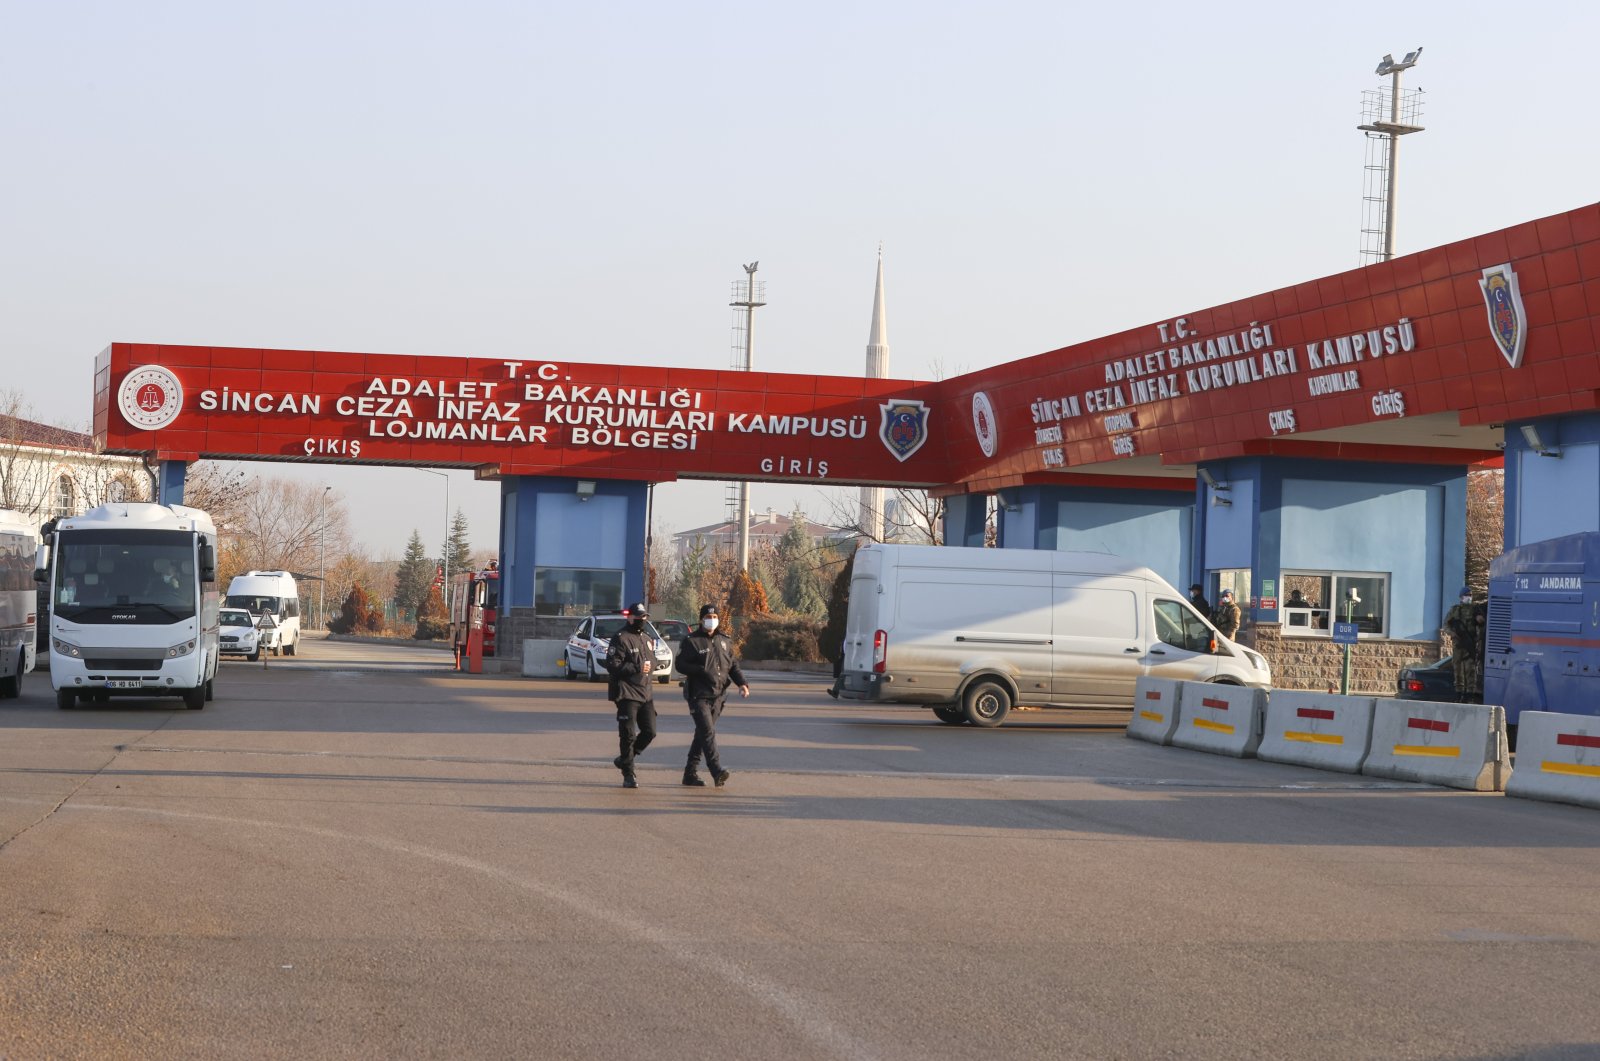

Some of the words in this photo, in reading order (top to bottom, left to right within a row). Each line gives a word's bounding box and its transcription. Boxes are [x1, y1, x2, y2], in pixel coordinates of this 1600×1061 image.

[1156, 317, 1197, 343] T.C.
[1104, 350, 1166, 383] ADALET
[1169, 321, 1274, 366] BAKANLIĞI
[504, 362, 571, 381] T.C.
[1031, 393, 1081, 424] SİNCAN
[1085, 384, 1124, 413] CEZA
[1131, 371, 1180, 405] İNFAZ
[1187, 348, 1297, 394] KURUMLARI
[1306, 318, 1415, 369] KAMPUSÜ
[1308, 370, 1360, 397] KURUMLAR
[366, 377, 497, 399] ADALET
[525, 384, 701, 409] BAKANLIĞI
[1371, 389, 1405, 418] GİRİŞ
[199, 386, 320, 415] SİNCAN
[336, 396, 413, 418] CEZA
[438, 395, 520, 423] İNFAZ
[544, 405, 714, 431] KURUMLARI
[728, 412, 867, 439] KAMPUSÜ
[1104, 412, 1134, 434] OTOPARK
[1268, 409, 1296, 436] ÇIKIŞ
[304, 438, 361, 458] ÇIKIŞ
[369, 420, 547, 444] LOJMANLAR
[572, 425, 697, 450] BÖLGESİ
[1112, 433, 1135, 457] GİRİŞ
[761, 458, 829, 478] GİRİŞ
[1042, 448, 1065, 470] ÇIKIŞ
[1540, 577, 1582, 590] JANDARMA
